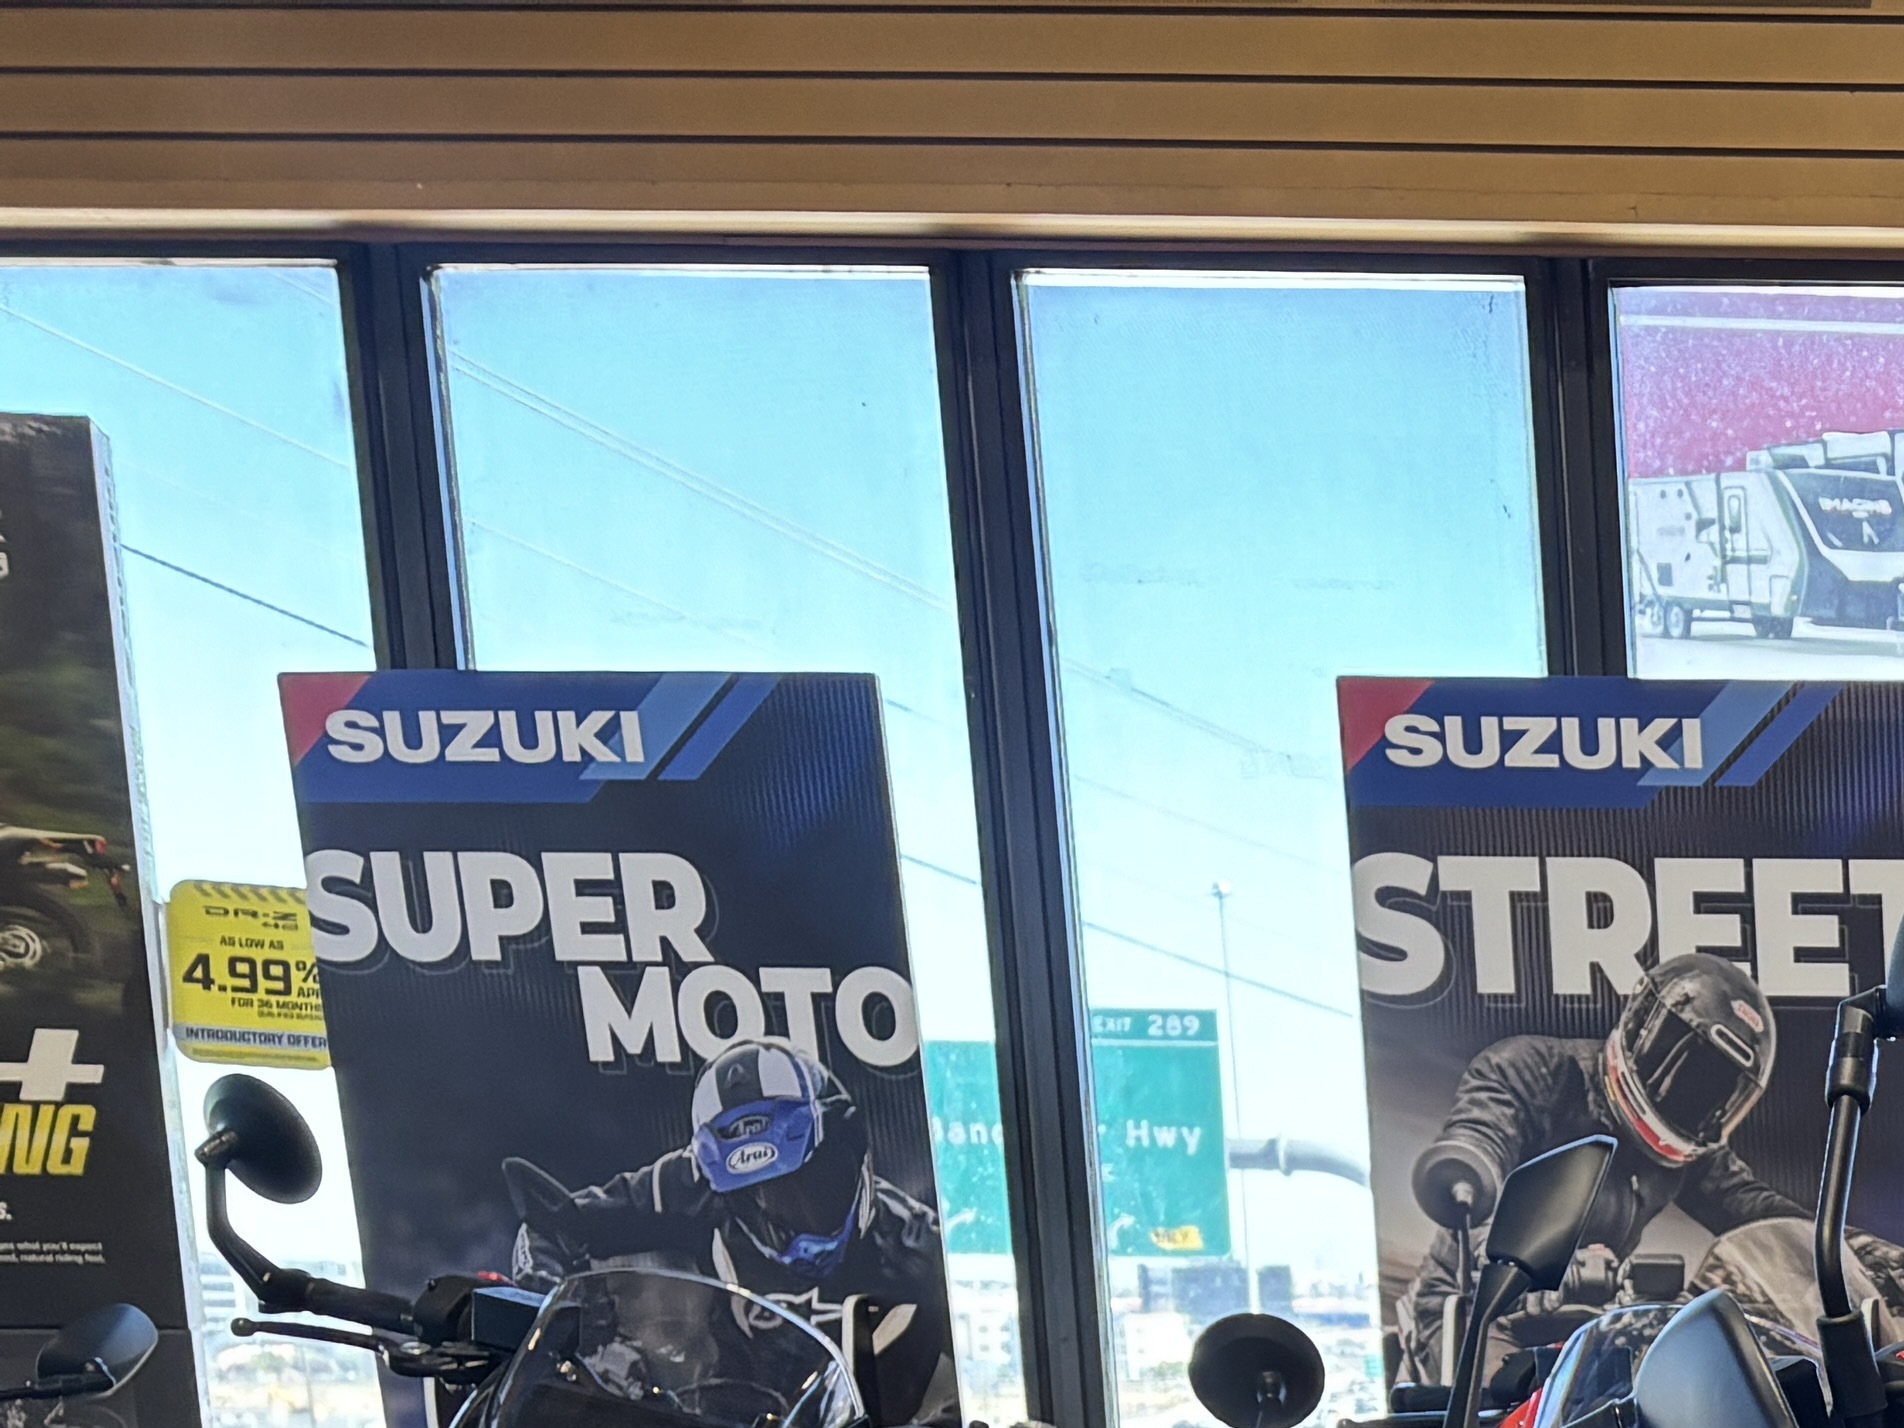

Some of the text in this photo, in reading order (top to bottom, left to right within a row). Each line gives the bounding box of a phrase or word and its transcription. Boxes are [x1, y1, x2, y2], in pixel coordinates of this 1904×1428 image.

[325, 709, 645, 764] SUZUKI
[1383, 714, 1704, 770] SUZUKI
[308, 851, 716, 963] SUPER
[239, 937, 265, 950] LOW
[577, 965, 918, 1067] MOTO
[1147, 1014, 1200, 1036] 289
[186, 1026, 285, 1046] INTRODUCTORY
[1126, 1119, 1201, 1156] Hwy
[732, 1146, 768, 1170] Arai
